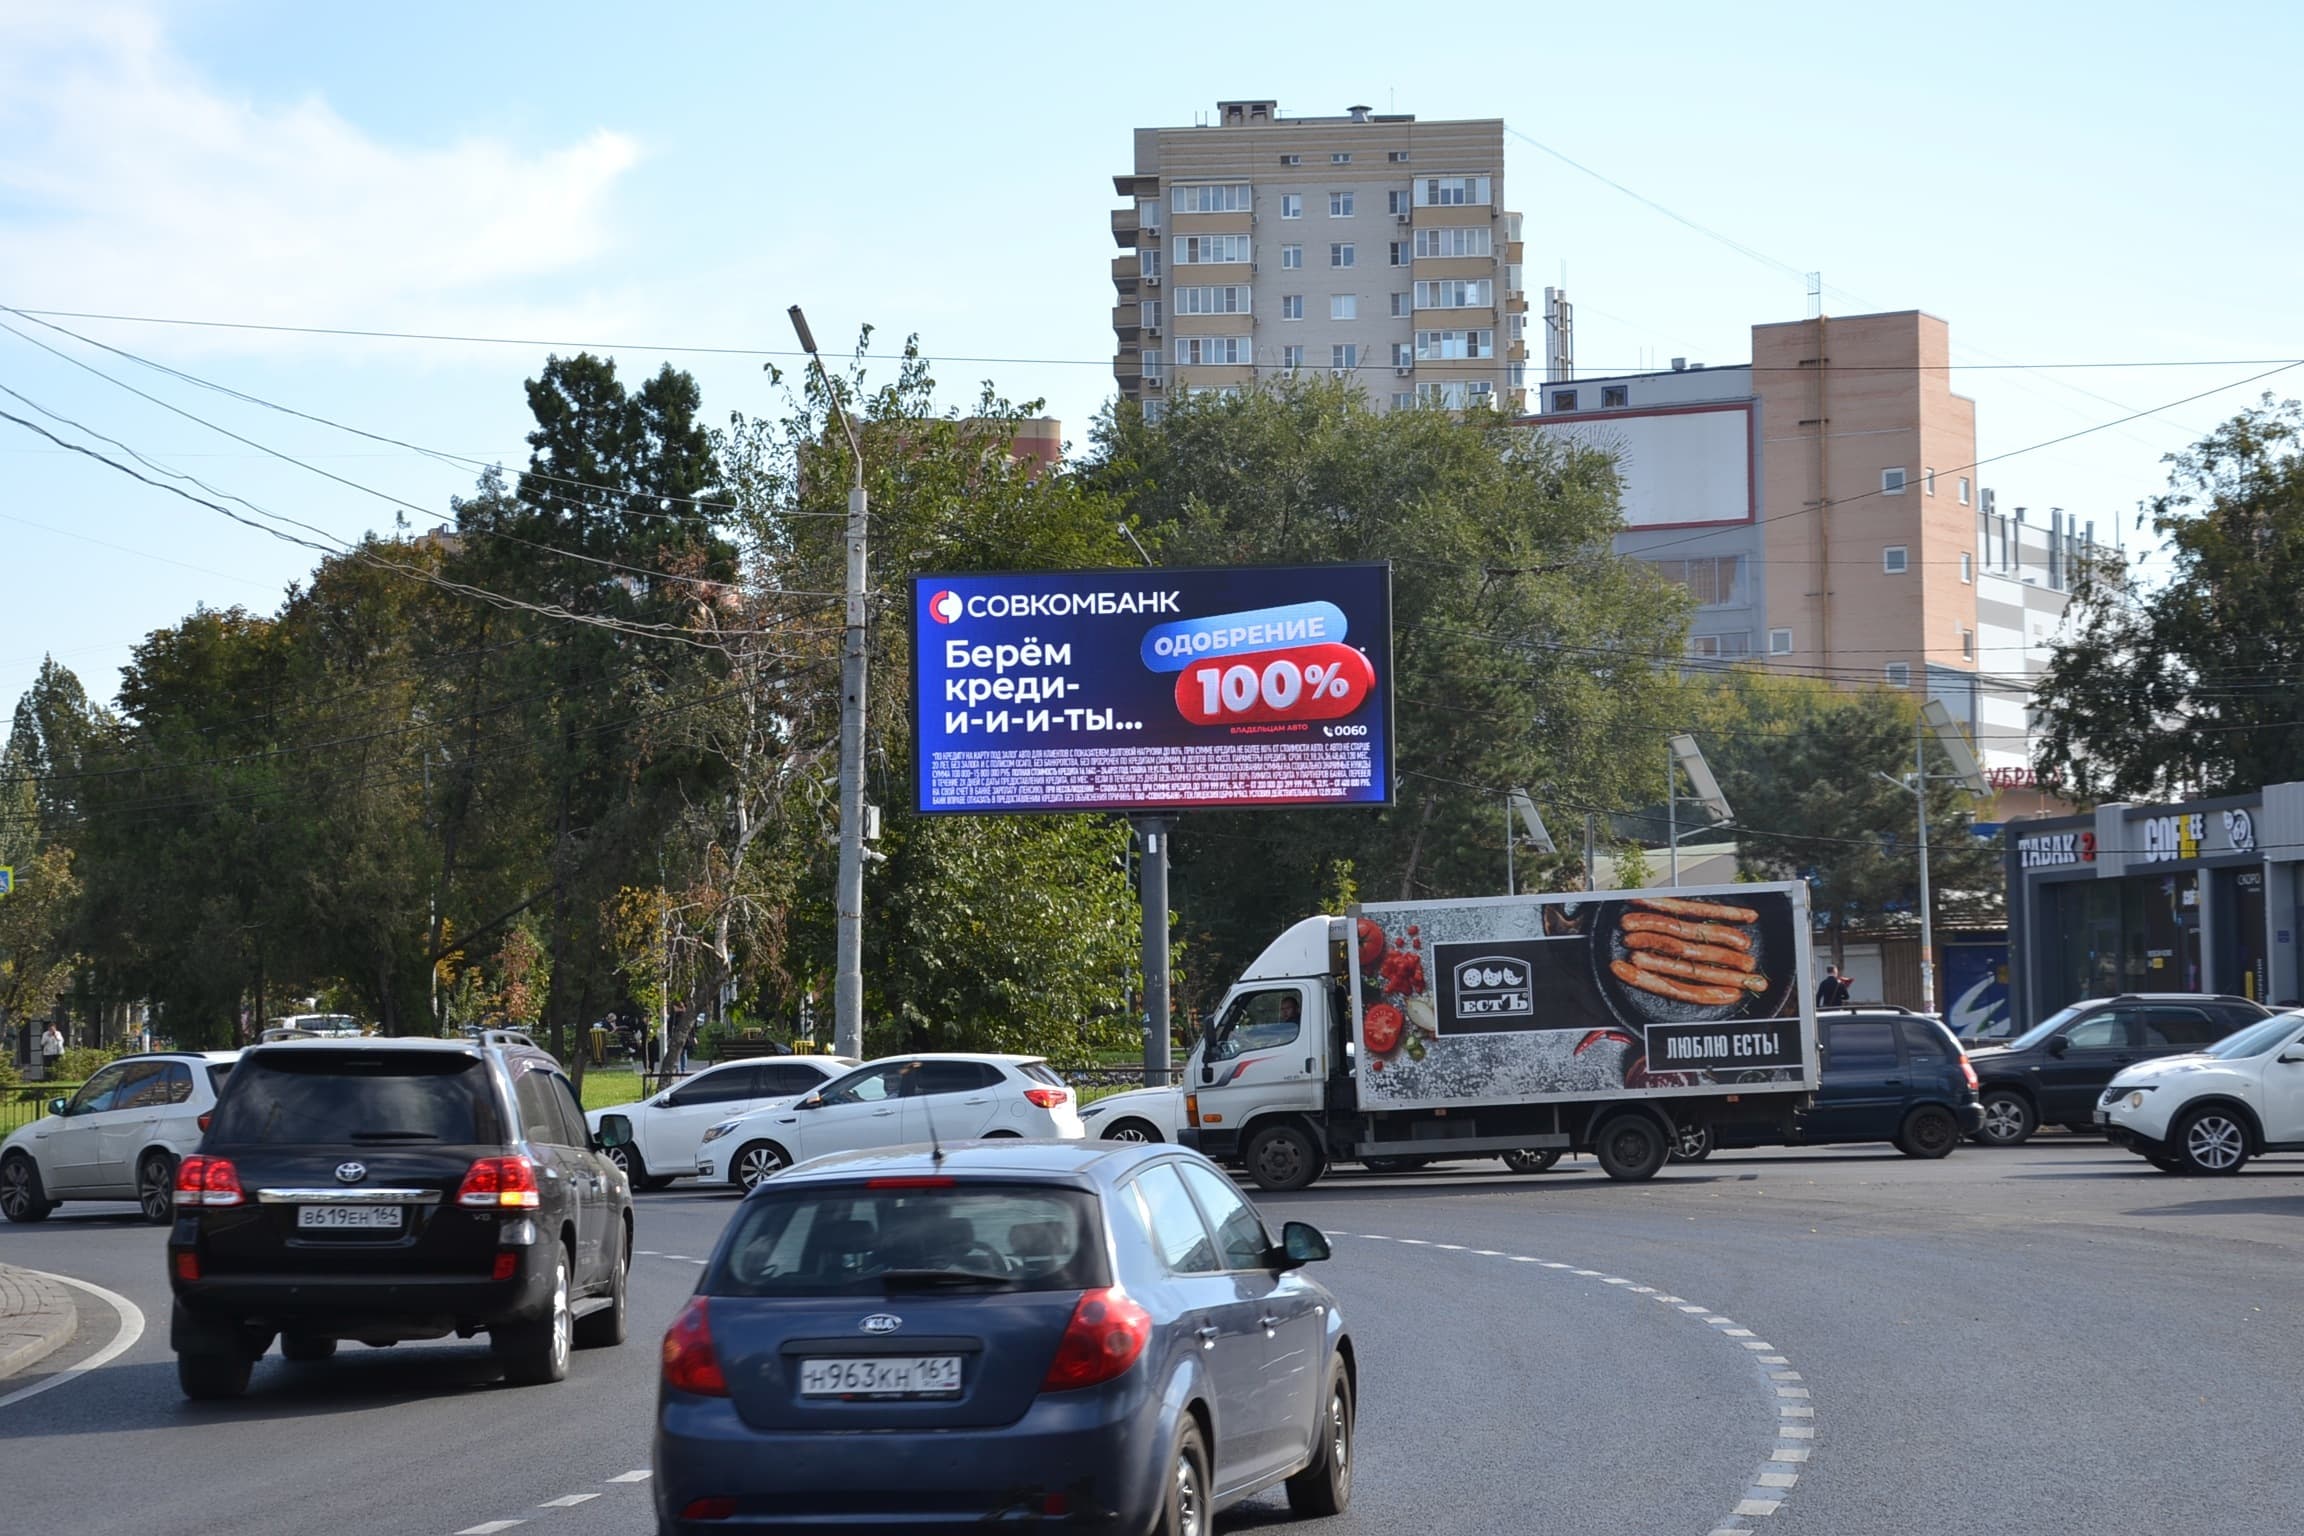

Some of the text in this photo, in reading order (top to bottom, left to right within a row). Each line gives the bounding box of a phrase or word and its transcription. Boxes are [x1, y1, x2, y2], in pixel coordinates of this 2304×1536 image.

[967, 591, 1181, 618] СОВКОМБАНК
[1154, 617, 1326, 657] ОДОБРЕНИЕ
[946, 636, 1072, 674] Берём
[946, 676, 1080, 707] креди-
[1197, 660, 1350, 715] 100%
[1230, 725, 1286, 734] ВЛАДЕЛЬЦАМ
[1334, 725, 1367, 736] 0060
[2018, 832, 2097, 867] ТАБАК 2
[1666, 1033, 1780, 1059] ЛЮБЛЮ ЕСТЬ!
